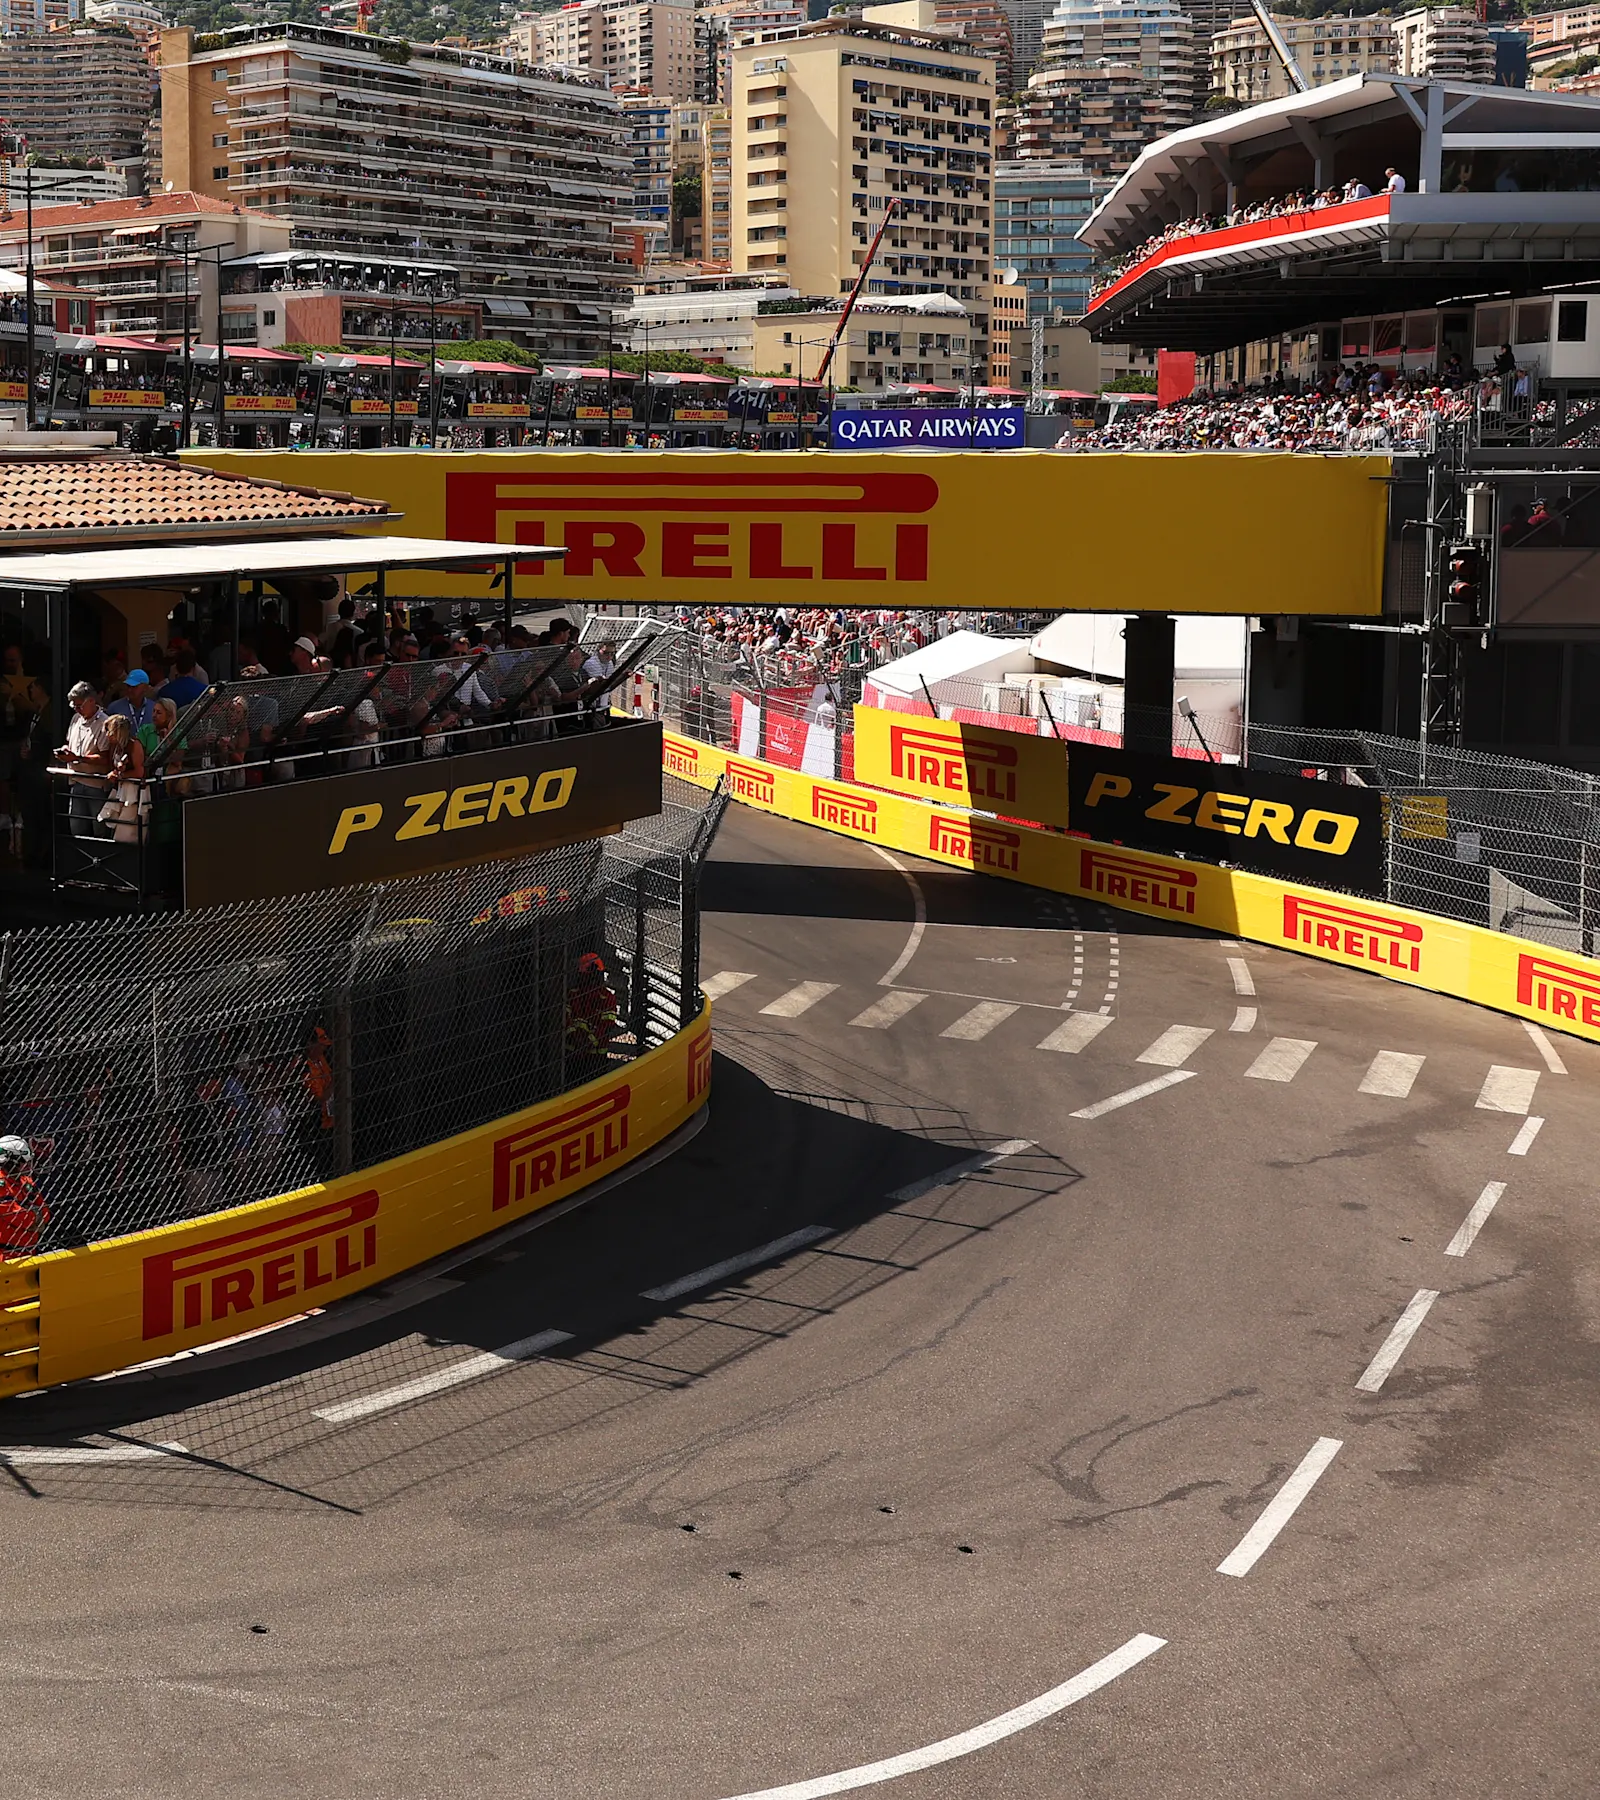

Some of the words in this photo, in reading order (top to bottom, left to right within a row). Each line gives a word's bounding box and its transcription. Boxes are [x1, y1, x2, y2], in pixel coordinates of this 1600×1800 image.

[8, 385, 24, 398] DHL
[102, 392, 129, 404] DHL
[143, 393, 160, 404] DHL
[235, 398, 262, 408] DHL
[274, 399, 292, 409] DHL
[362, 402, 385, 412] DHL
[399, 403, 414, 412] DHL
[684, 411, 702, 419] DHL
[838, 419, 913, 443] QATAR
[918, 417, 1017, 438] AIRWAYS
[446, 472, 940, 582] PIRELLI
[726, 759, 775, 805] PIRELLI
[890, 725, 1019, 803] PIRELLI
[328, 803, 383, 855] P
[395, 766, 579, 841] ZERO
[812, 785, 878, 835] PIRELLI
[1084, 773, 1132, 807] P
[1144, 783, 1360, 856] ZERO
[930, 815, 1021, 872] PIRELLI
[1080, 848, 1198, 914] PIRELLI
[1283, 894, 1423, 973] PIRELLI
[492, 1083, 631, 1212] PIRELLI
[142, 1189, 380, 1341] PIRELLI
